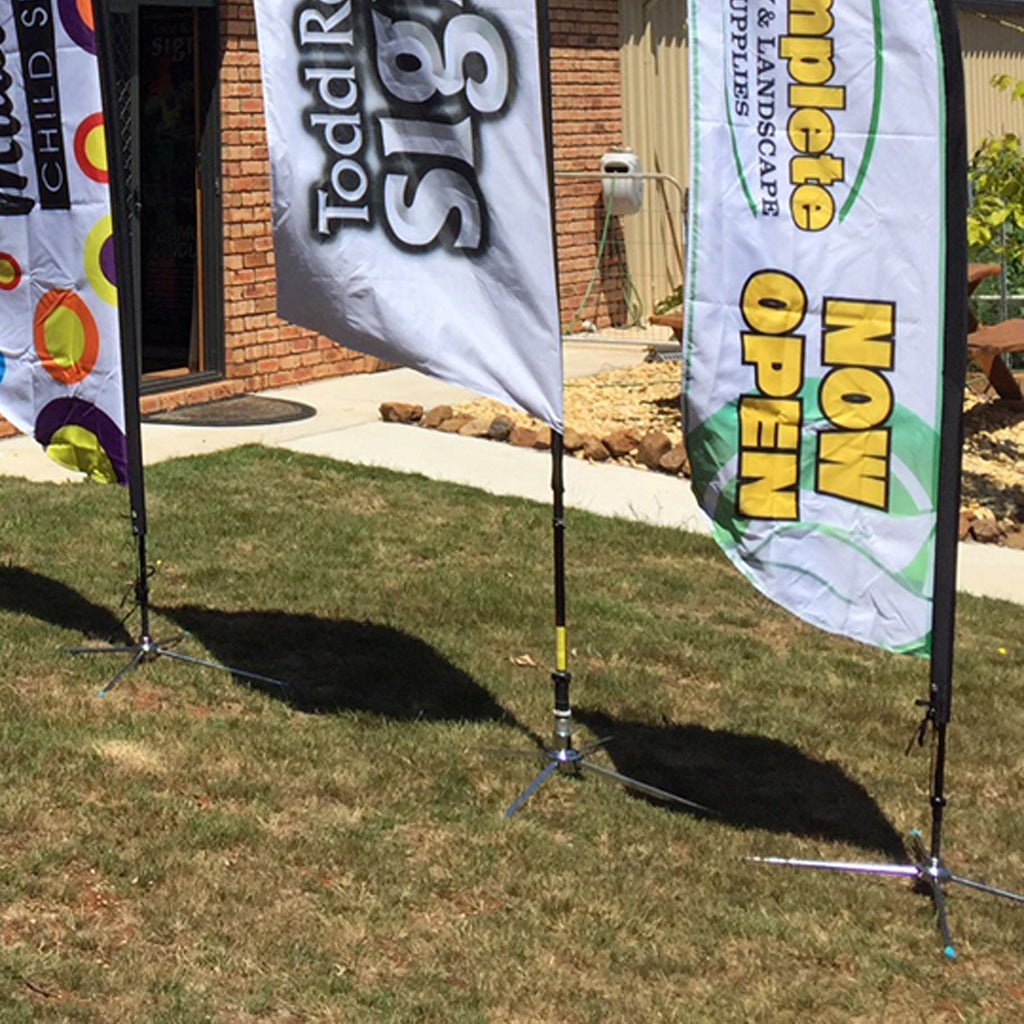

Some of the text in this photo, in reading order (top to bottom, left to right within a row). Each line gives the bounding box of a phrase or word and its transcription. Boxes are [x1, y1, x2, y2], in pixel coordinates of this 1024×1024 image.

[757, 9, 775, 29] &
[26, 50, 64, 193] CHILD
[306, 69, 370, 237] Todd
[756, 37, 780, 218] LANDSCAPE
[736, 268, 808, 521] OPEN
[815, 295, 896, 513] NOW
